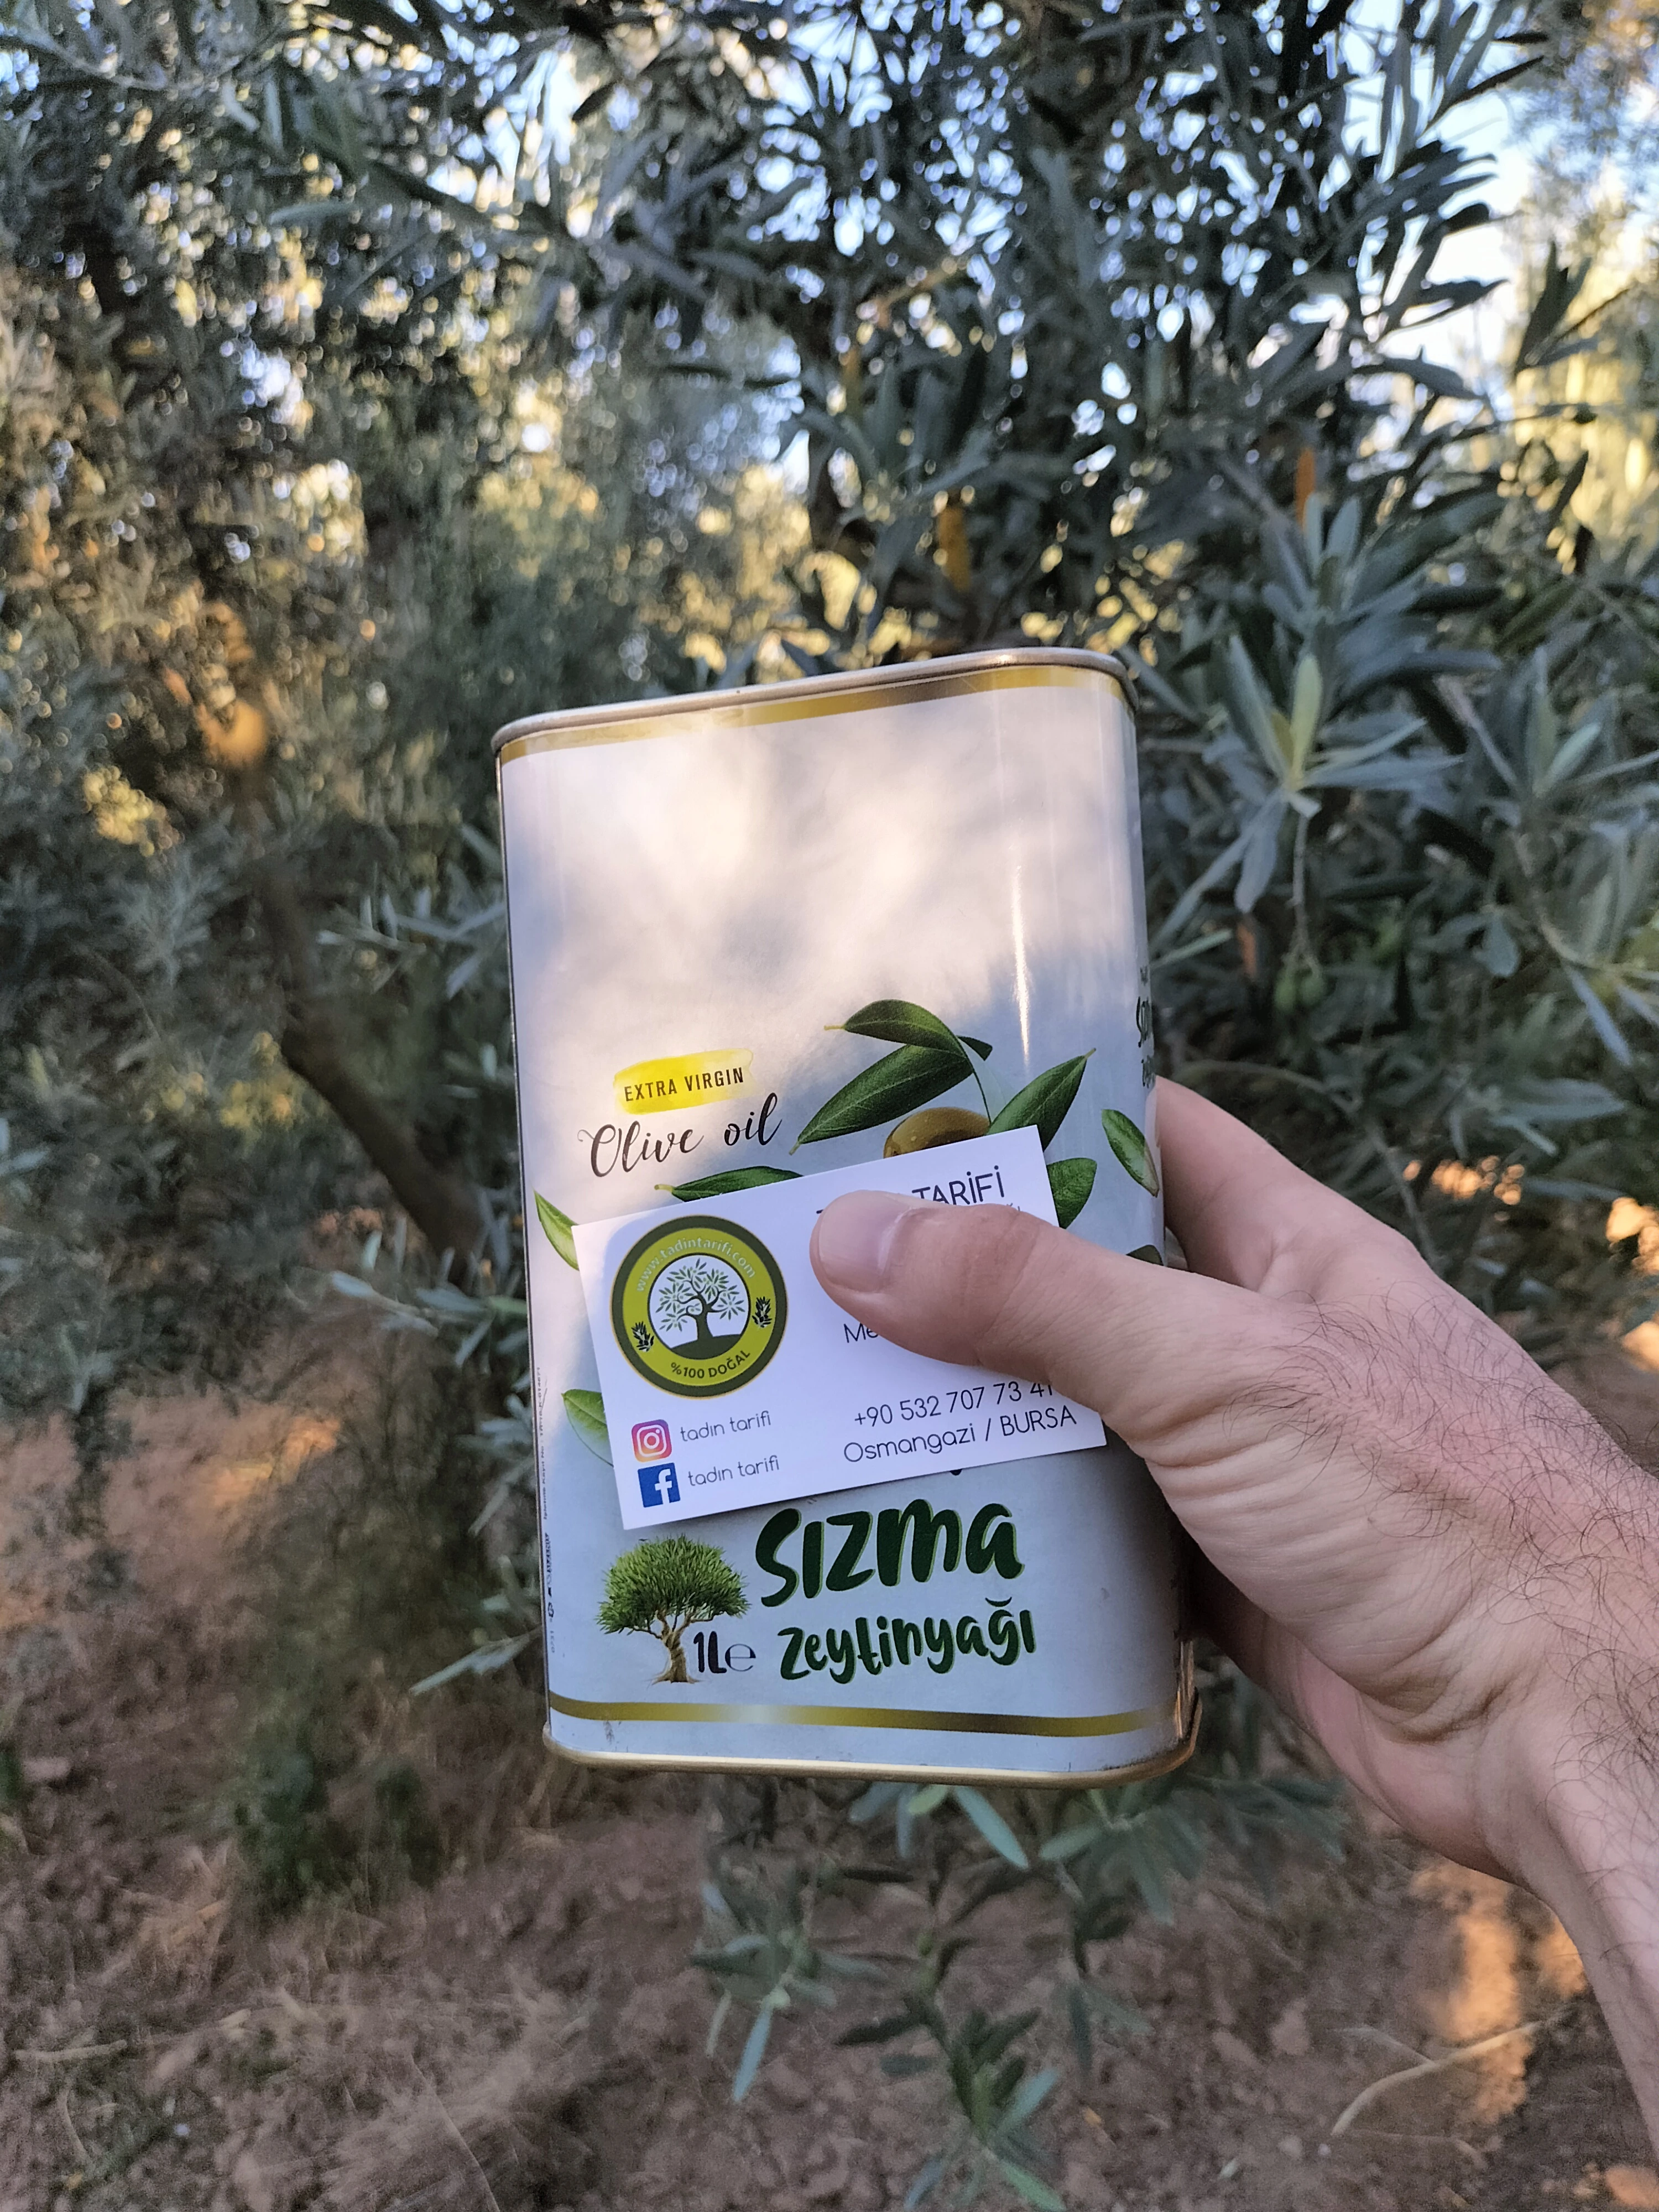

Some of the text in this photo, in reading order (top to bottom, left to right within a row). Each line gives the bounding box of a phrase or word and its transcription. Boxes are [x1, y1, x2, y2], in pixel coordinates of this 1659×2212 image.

[624, 1067, 744, 1102] EXTRA VIRGIN
[577, 1092, 782, 1177] Olive oil
[671, 1349, 751, 1379] %100 DOĞAL
[854, 1404, 893, 1427] +90
[900, 1395, 942, 1421] 532
[946, 1386, 985, 1413] 707
[993, 1381, 1022, 1405] 73
[680, 1410, 772, 1442] tadın tarifi
[844, 1405, 1077, 1463] Osmangazi / BURSA
[688, 1455, 780, 1486] tadın tarifi
